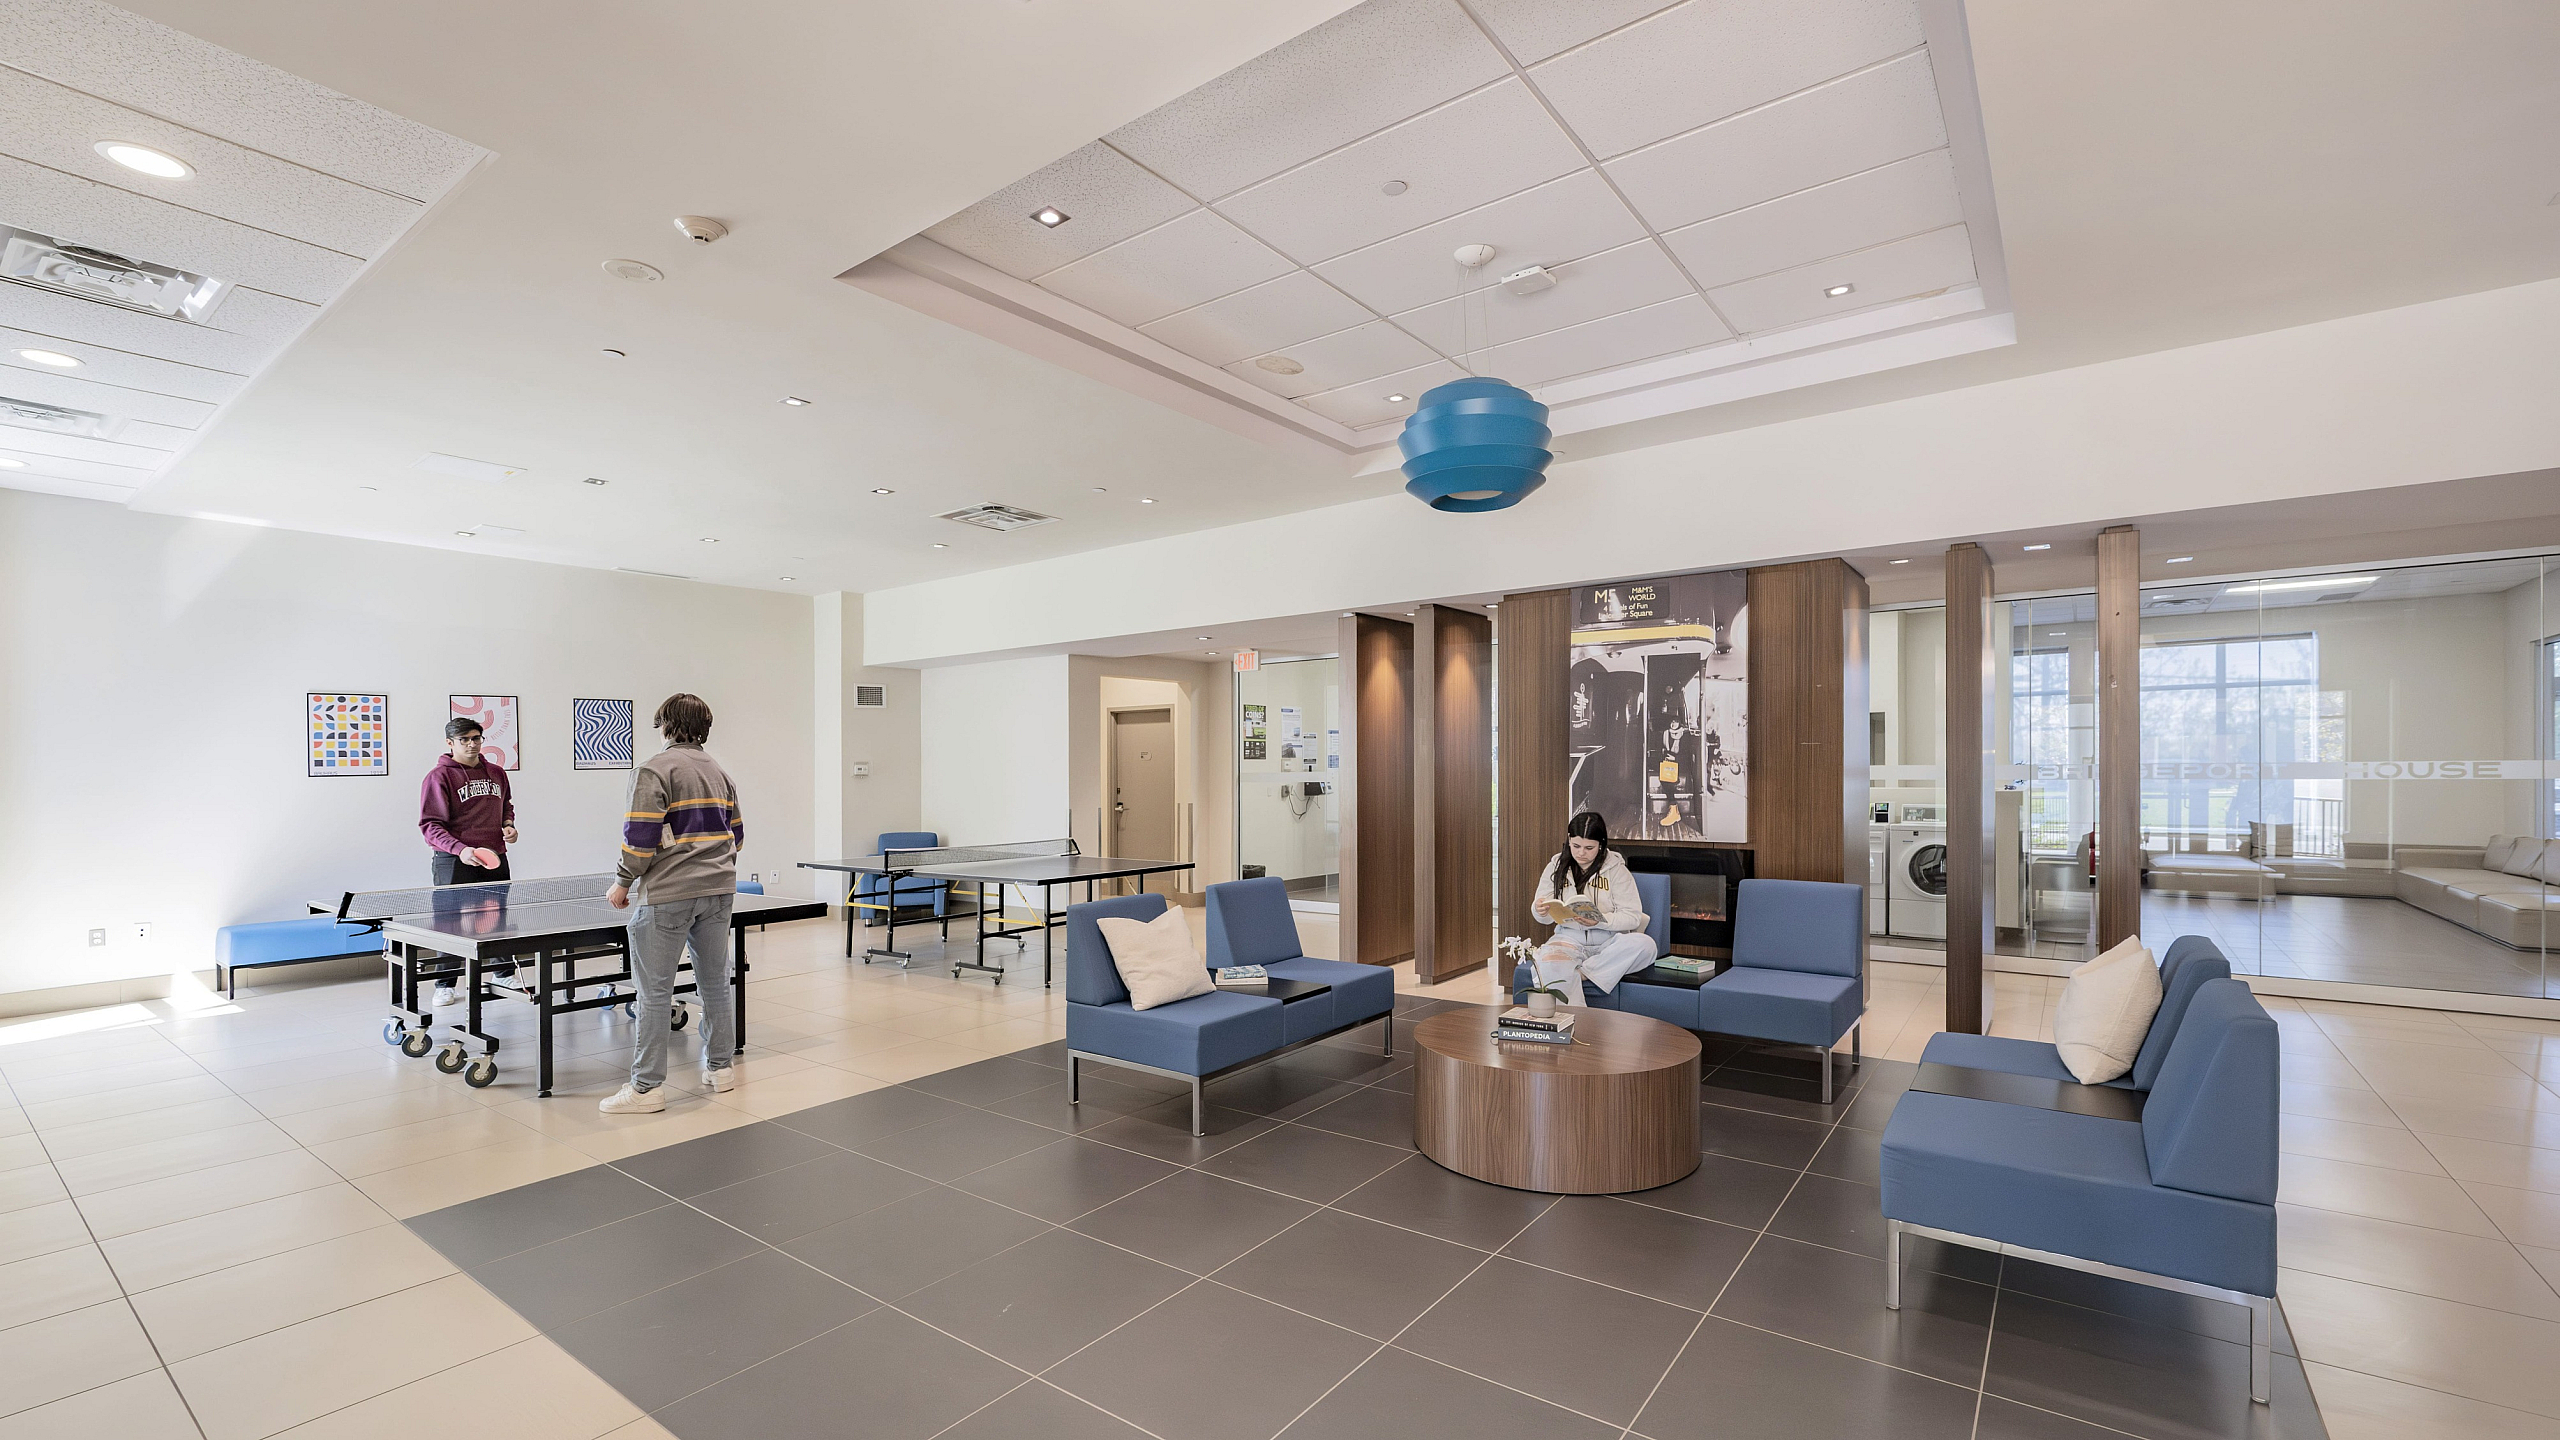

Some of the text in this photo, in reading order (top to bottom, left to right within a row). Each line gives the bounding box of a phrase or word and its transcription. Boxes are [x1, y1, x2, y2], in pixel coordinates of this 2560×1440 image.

[1631, 586, 1654, 594] M&M'S
[1628, 593, 1656, 602] WORLD
[1609, 603, 1628, 612] Lels
[1628, 602, 1636, 610] of
[1636, 602, 1649, 610] Fun
[1629, 610, 1654, 619] Square
[1238, 652, 1255, 671] EXIT
[1245, 711, 1265, 719] COINS?
[2037, 762, 2502, 780] BRIEPORT HOUSE
[1503, 1030, 1550, 1040] PLANTOPEDIA
